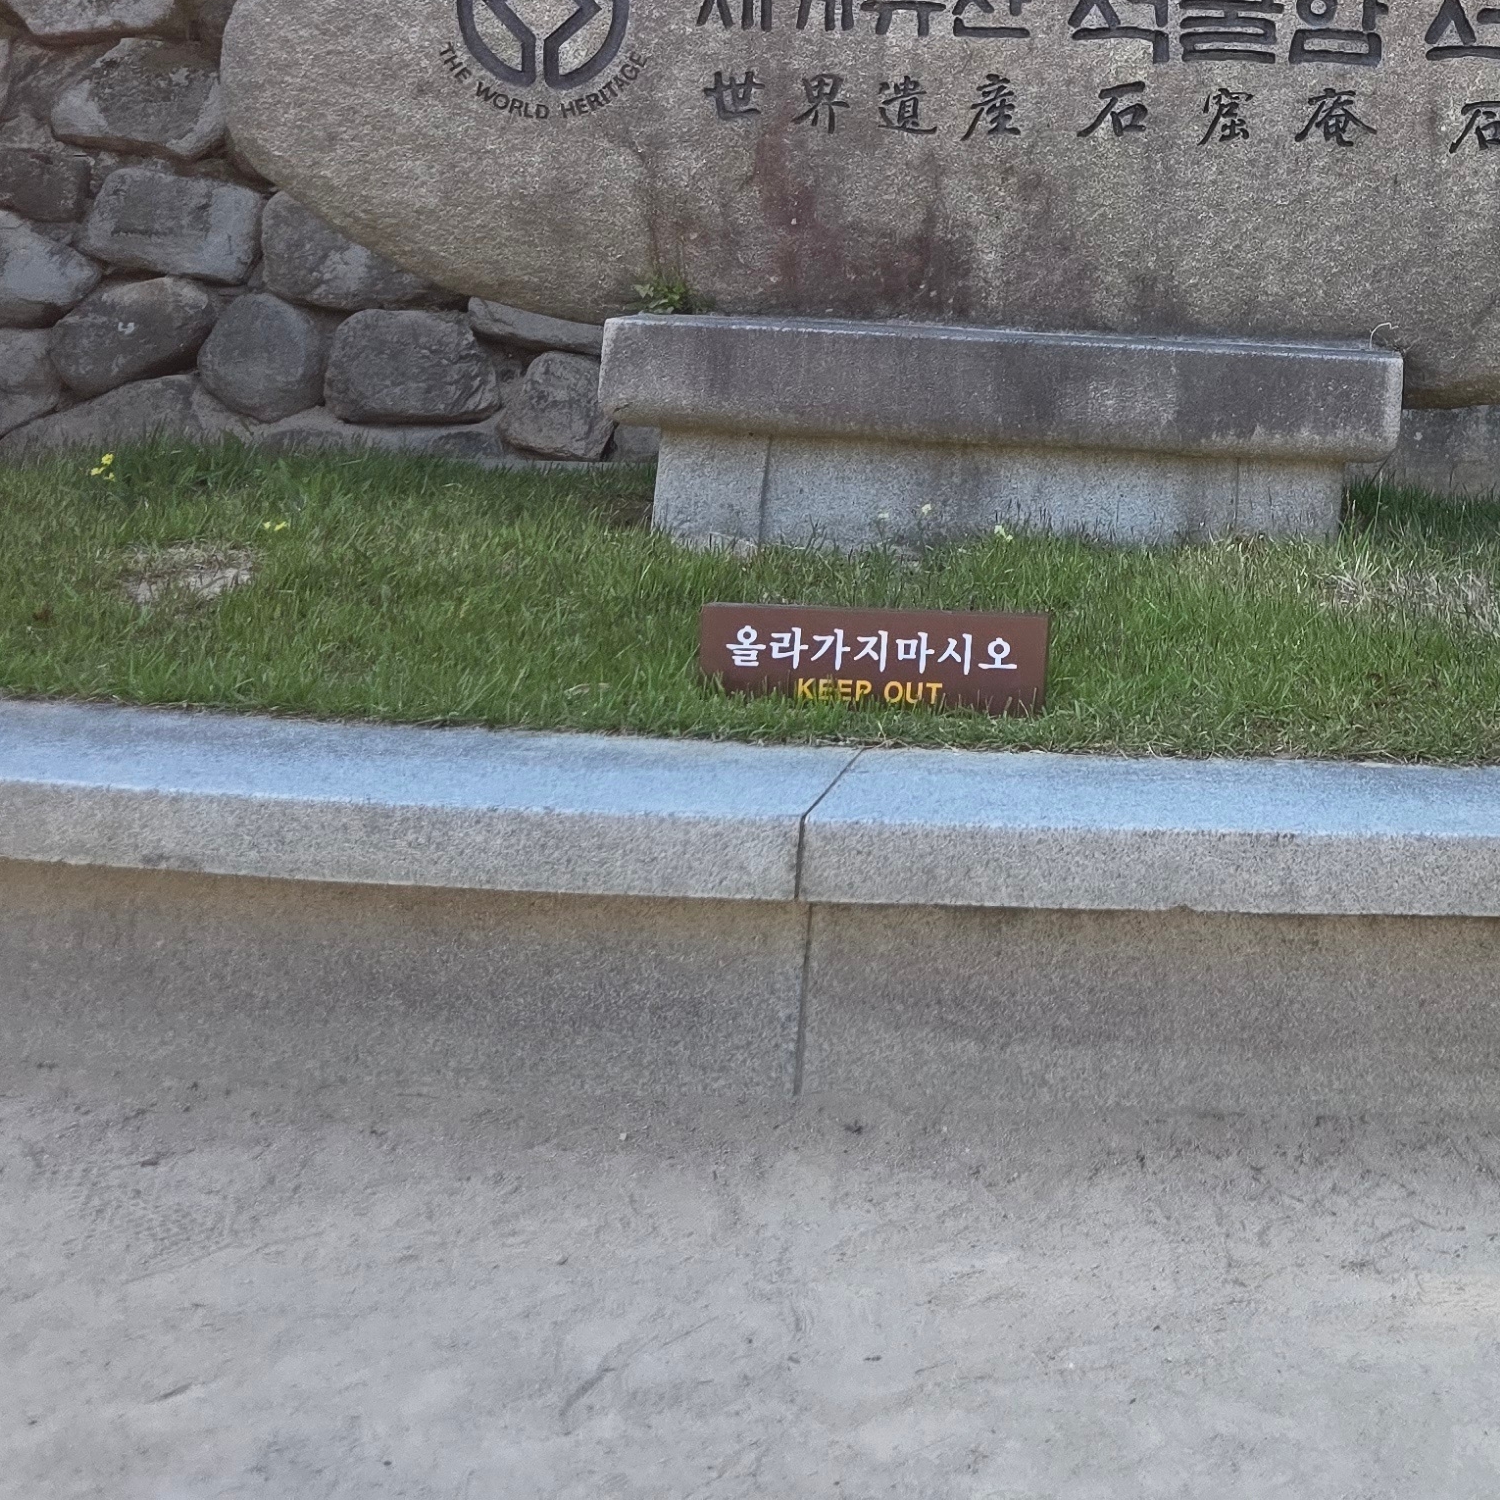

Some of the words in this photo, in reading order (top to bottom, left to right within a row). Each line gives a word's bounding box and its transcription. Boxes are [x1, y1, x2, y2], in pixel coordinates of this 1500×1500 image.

[439, 41, 472, 83] THE
[475, 81, 550, 119] WORLD
[560, 51, 649, 119] HERITAGE
[725, 625, 1018, 675] 올라가지마시오
[797, 677, 872, 702] KEEP
[883, 680, 943, 704] OUT
